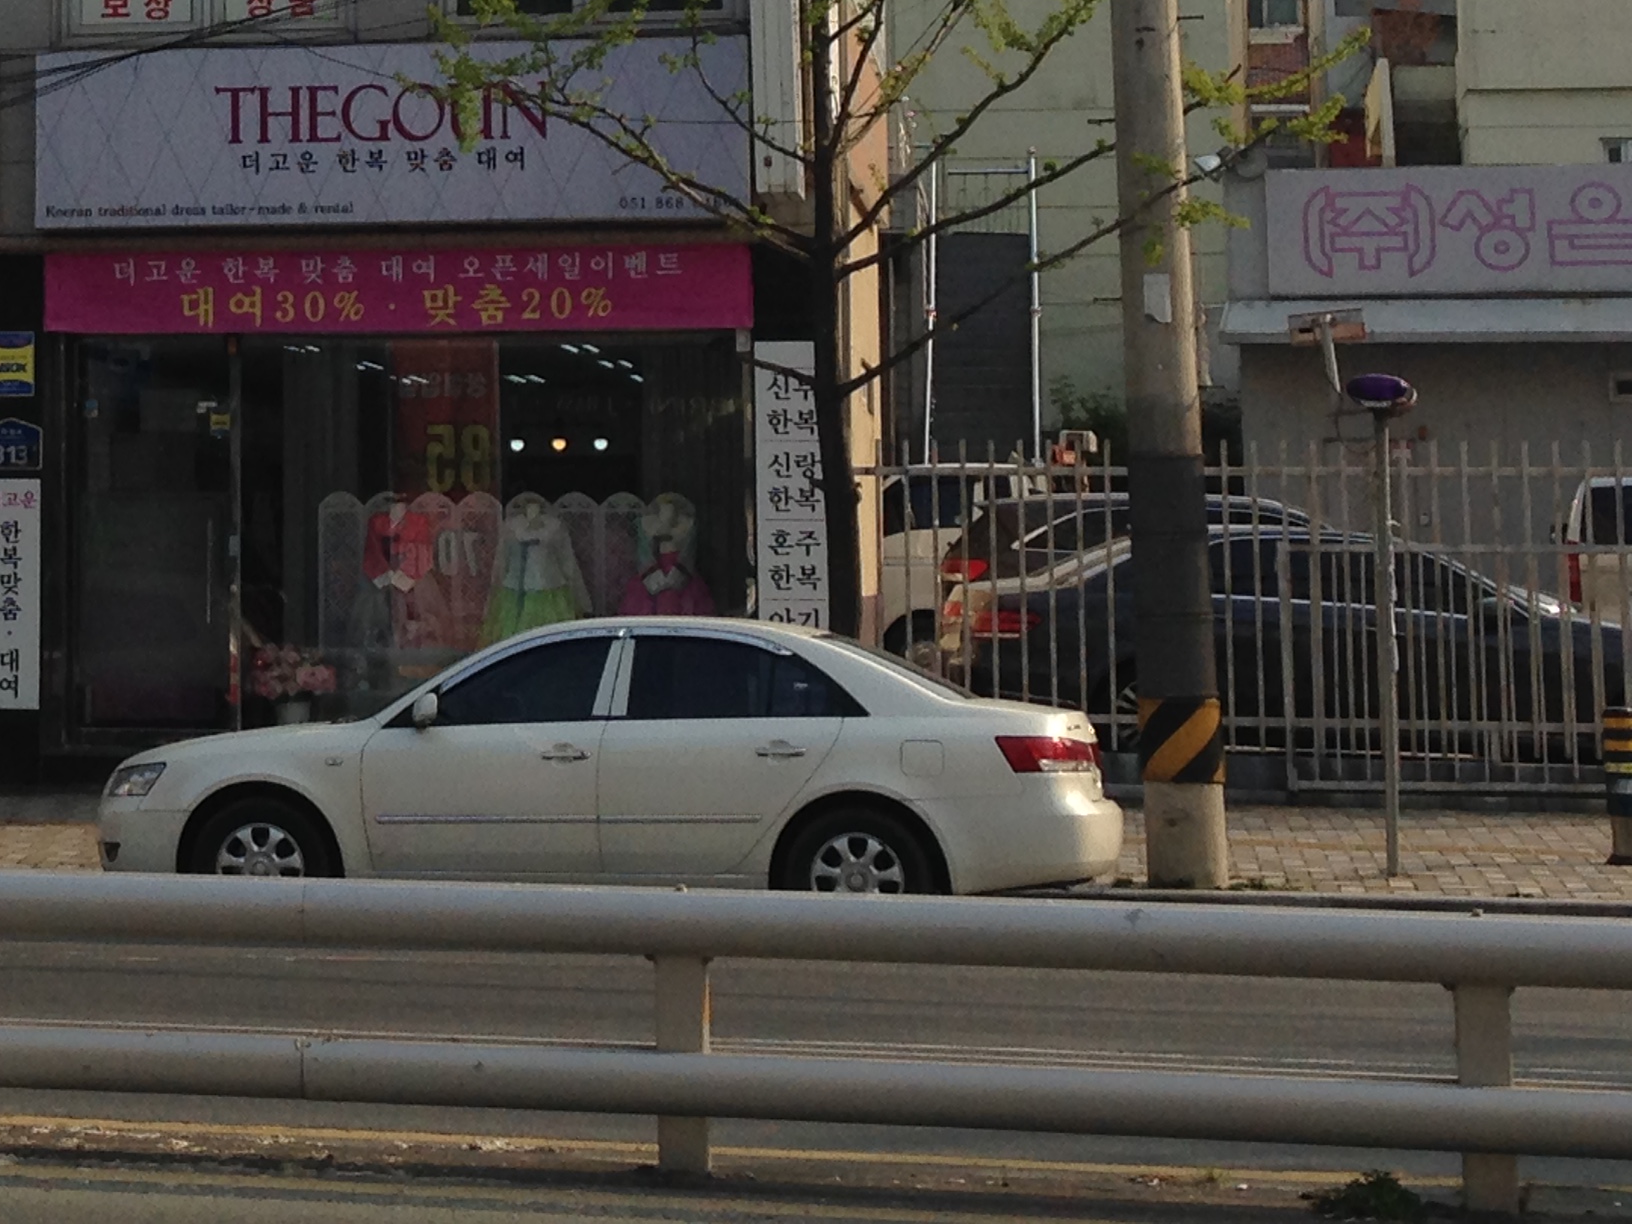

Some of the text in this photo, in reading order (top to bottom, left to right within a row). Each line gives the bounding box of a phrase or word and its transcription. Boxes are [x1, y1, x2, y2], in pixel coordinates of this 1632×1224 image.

[241, 145, 527, 175] 더고운 한복 맞춤 대여
[97, 204, 166, 217] traditional
[113, 257, 202, 286] 더고운
[222, 256, 280, 284] 한복
[299, 255, 358, 284] 맞춤
[380, 255, 435, 283] 대여
[767, 407, 818, 437] 한복
[768, 450, 821, 480] 신랑
[768, 485, 821, 514] 한복
[768, 529, 821, 557] 혼주
[768, 563, 821, 592] 한복
